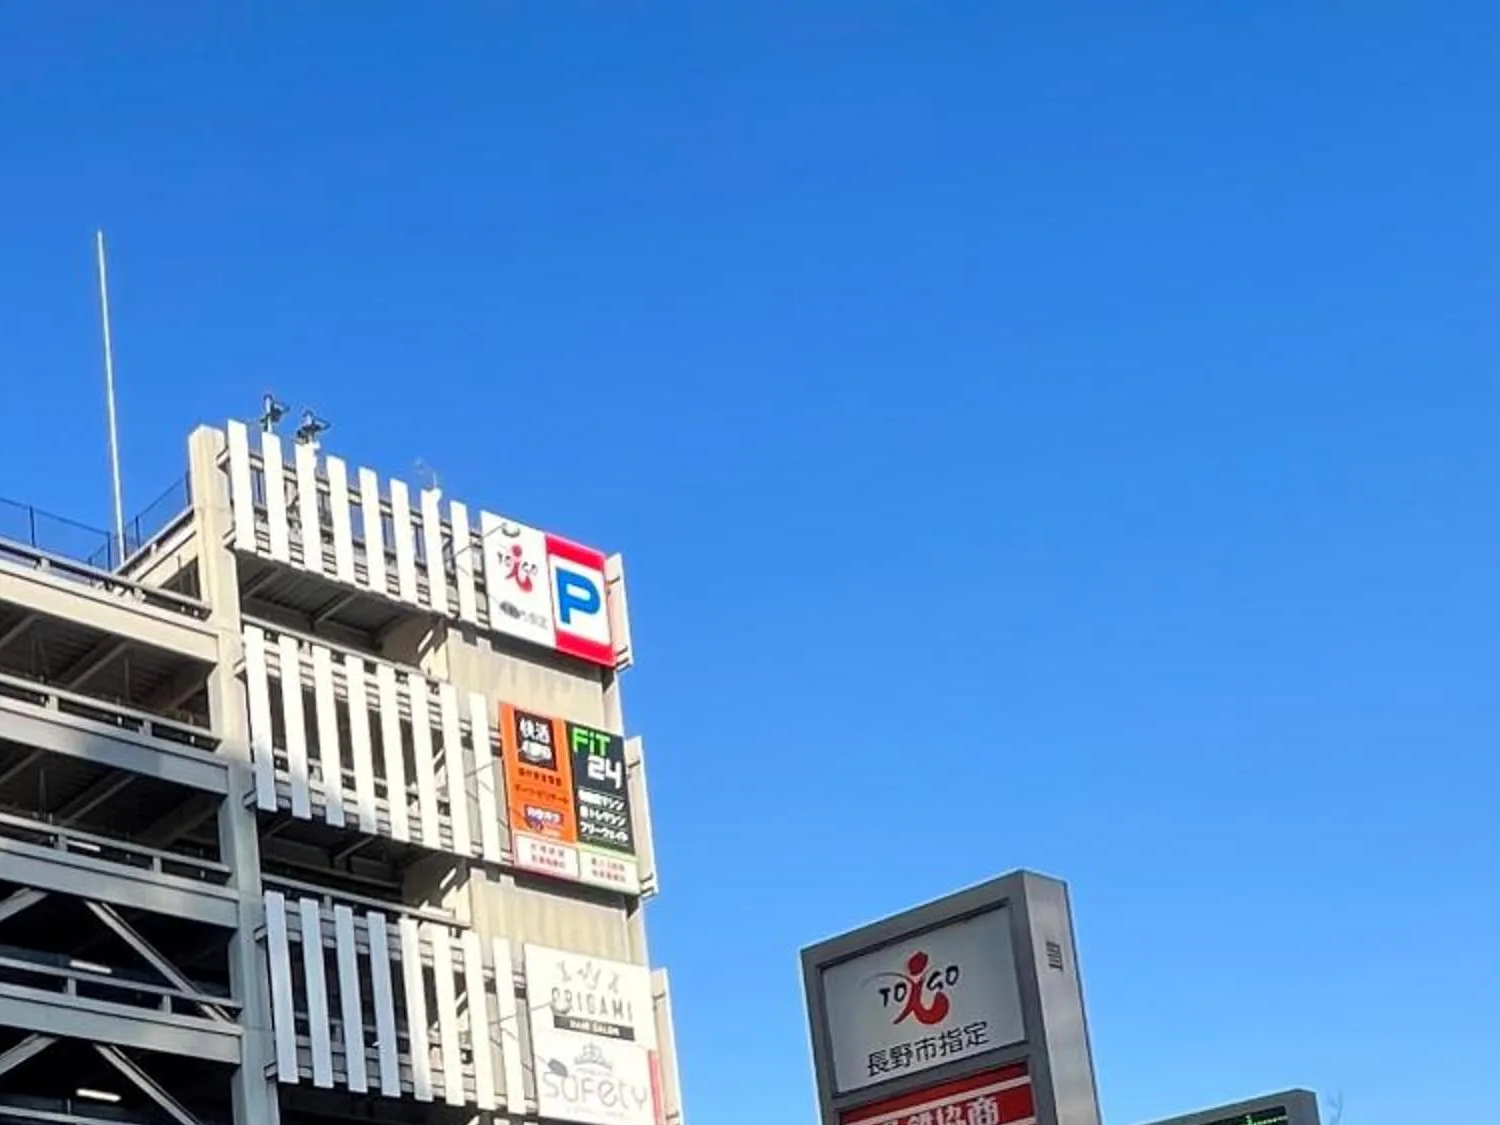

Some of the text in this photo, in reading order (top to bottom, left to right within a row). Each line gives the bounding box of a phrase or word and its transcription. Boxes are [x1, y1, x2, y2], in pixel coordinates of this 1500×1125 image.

[555, 566, 601, 625] P
[587, 755, 622, 789] 24
[867, 1021, 989, 1077] 長野市指定
